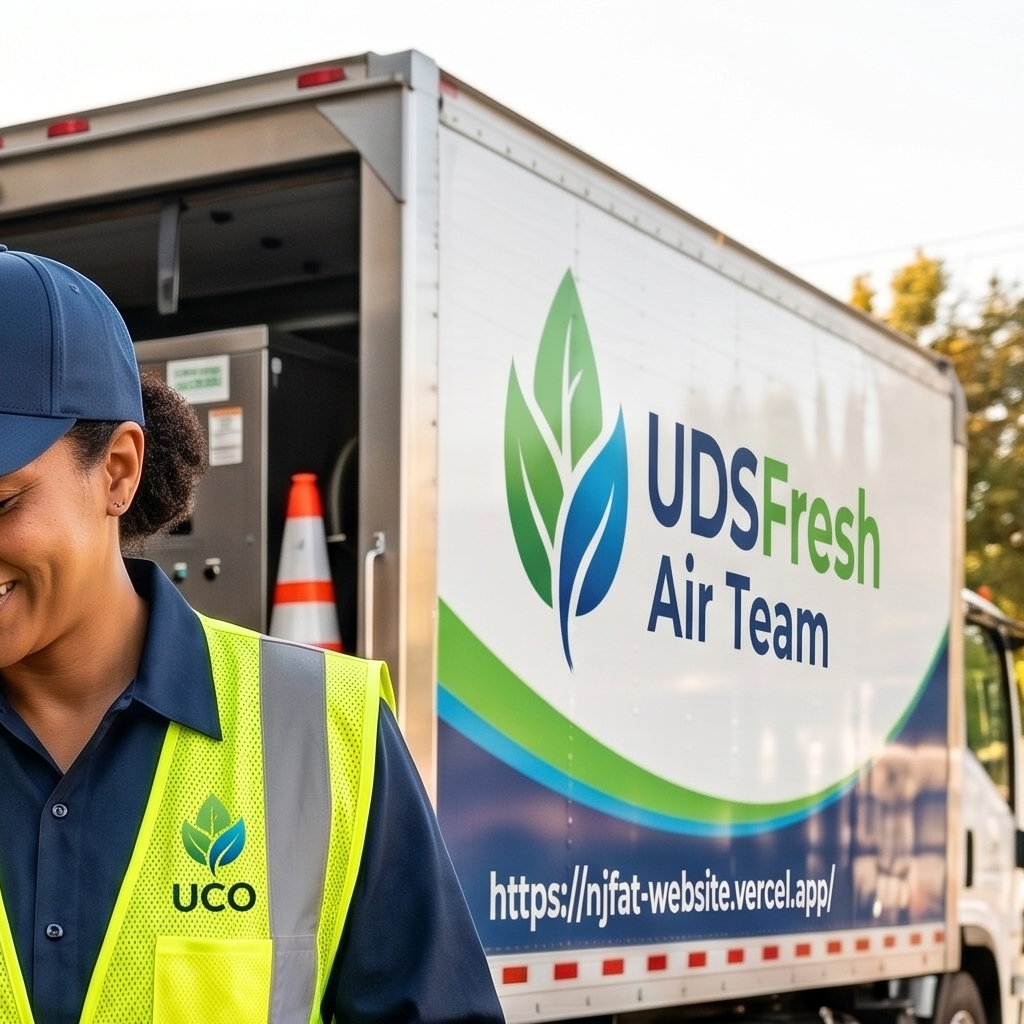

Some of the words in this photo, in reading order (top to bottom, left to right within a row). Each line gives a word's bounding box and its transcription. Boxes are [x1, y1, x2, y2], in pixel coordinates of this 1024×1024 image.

[648, 411, 881, 590] UDSFresh
[647, 552, 714, 643] Air
[725, 570, 829, 669] Team
[172, 882, 257, 912] UCO
[489, 863, 836, 932] https://njfat-website.vercel.app/
